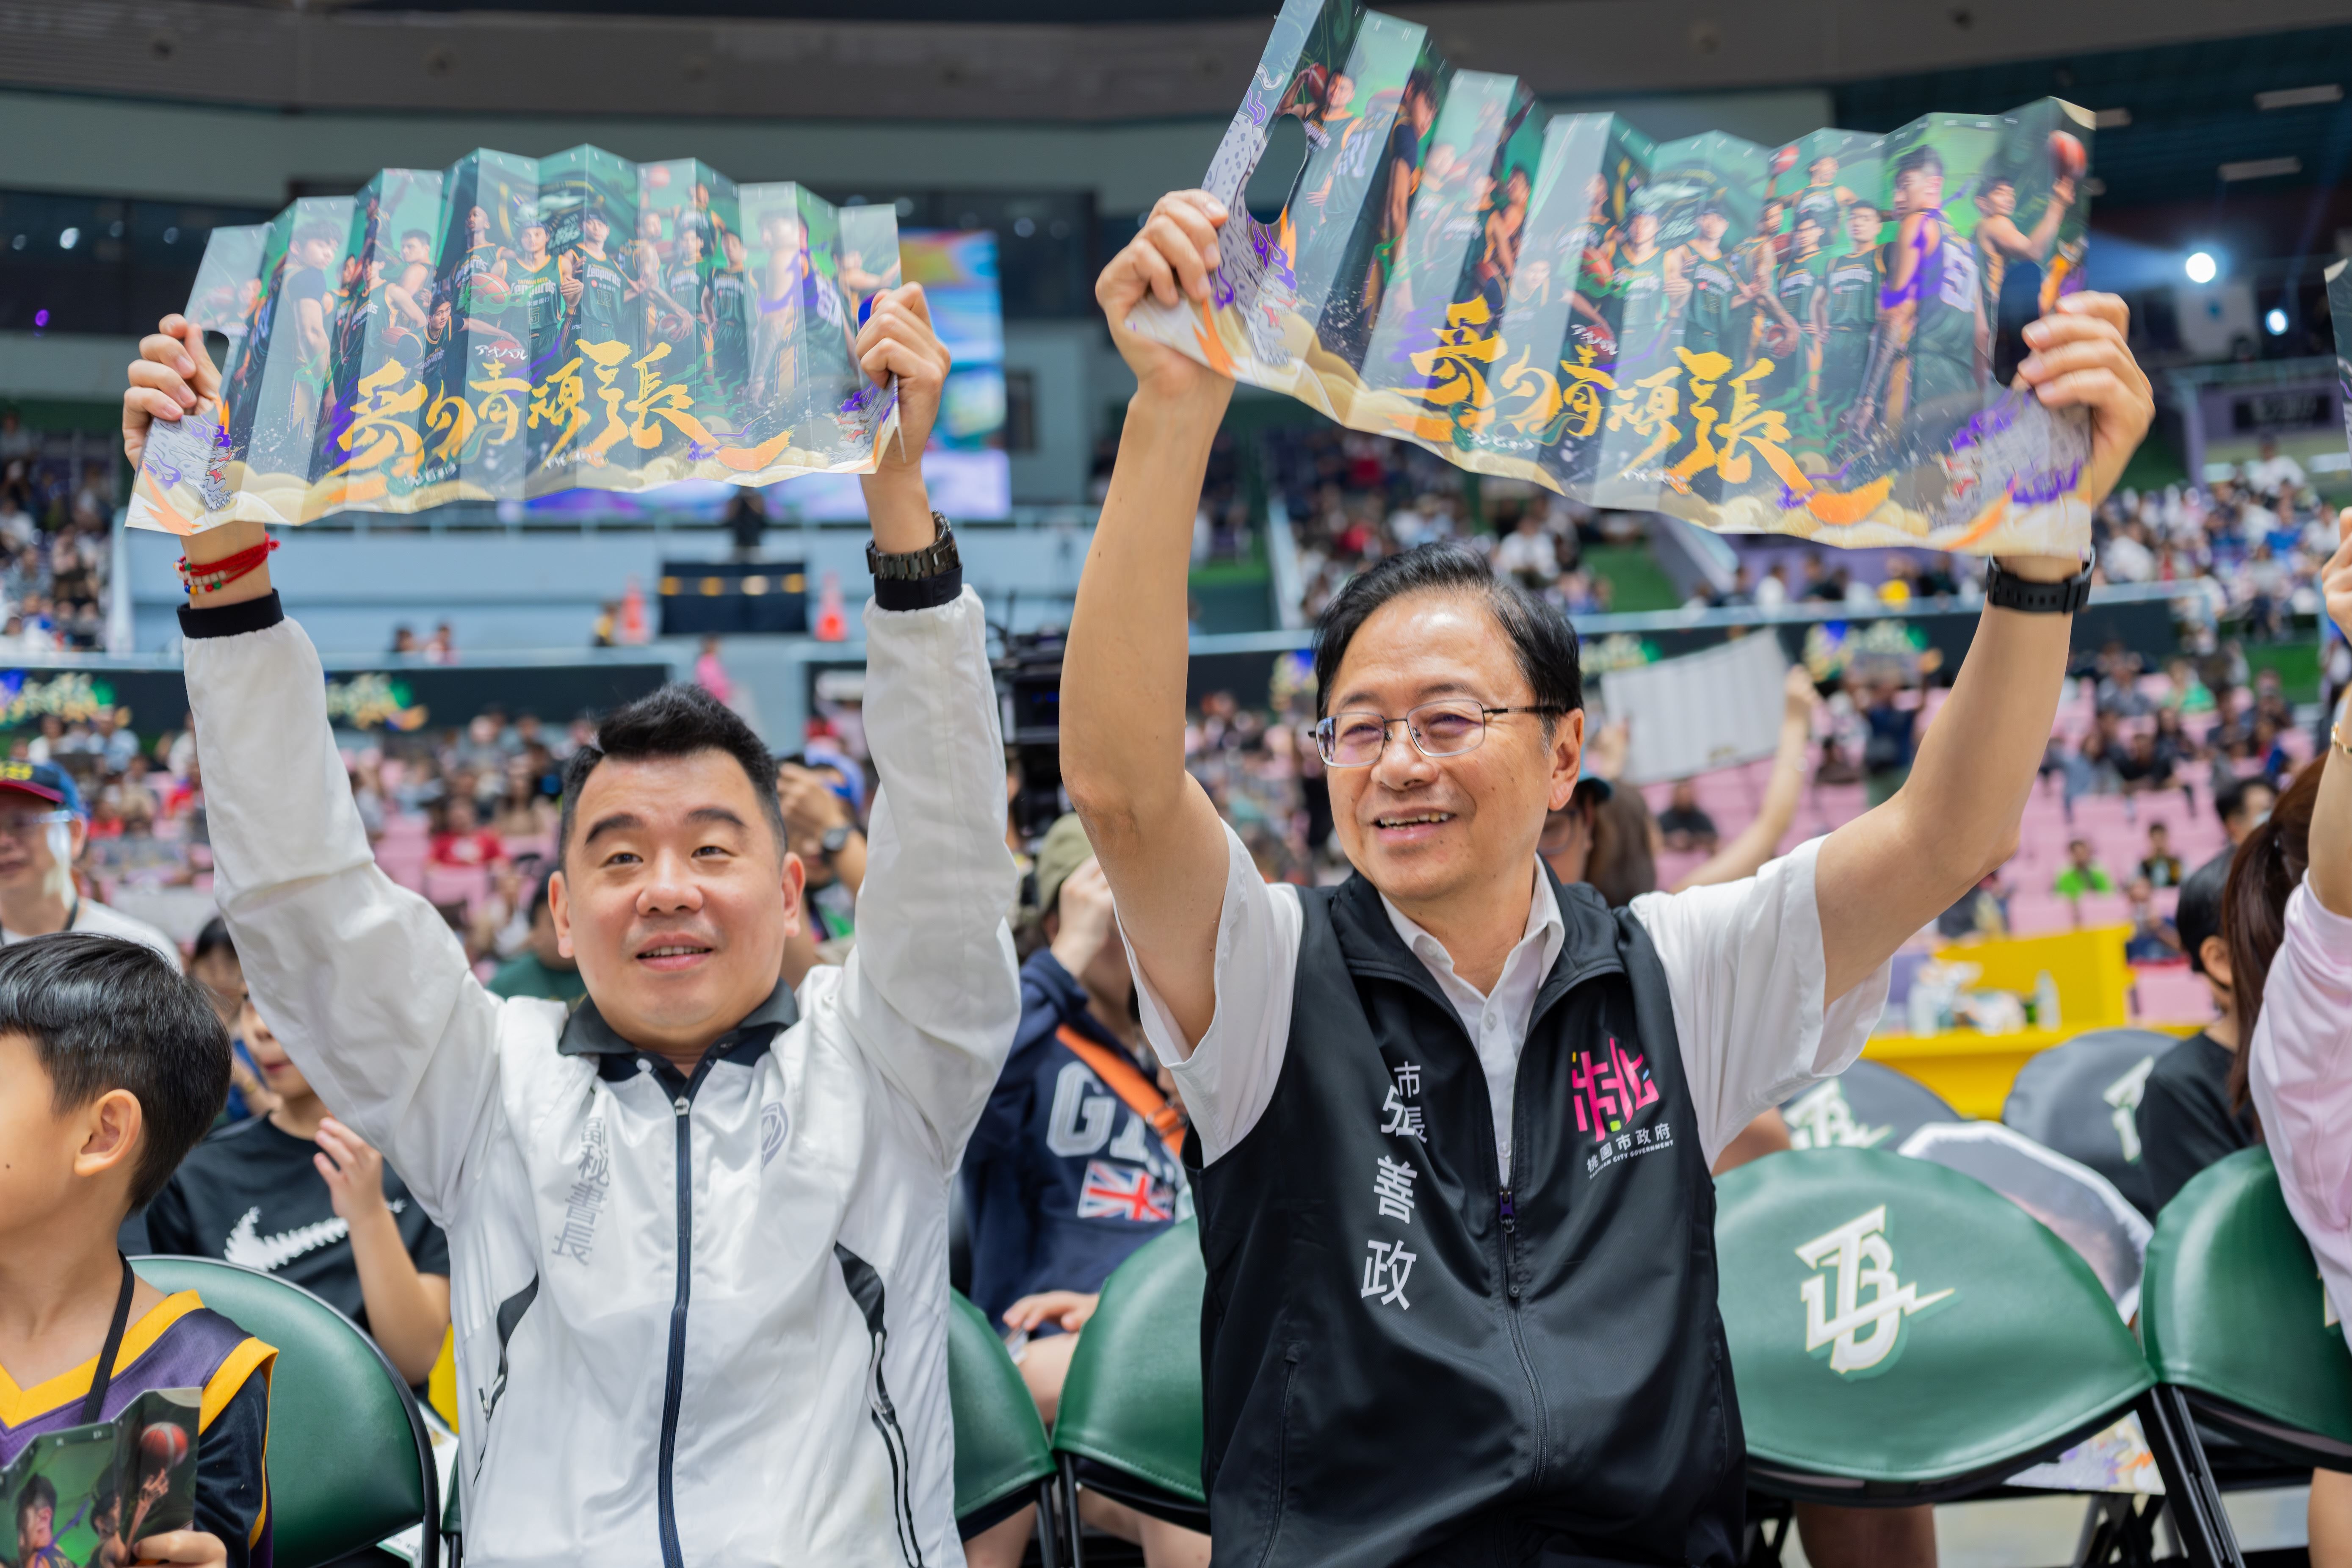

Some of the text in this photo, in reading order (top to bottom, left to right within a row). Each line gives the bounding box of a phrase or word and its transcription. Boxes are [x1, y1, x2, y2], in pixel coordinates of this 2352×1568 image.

[1586, 1123, 1670, 1173] 桃園市政府
[1589, 1139, 1674, 1180] TAOYUAN CITY GOVERNMENT
